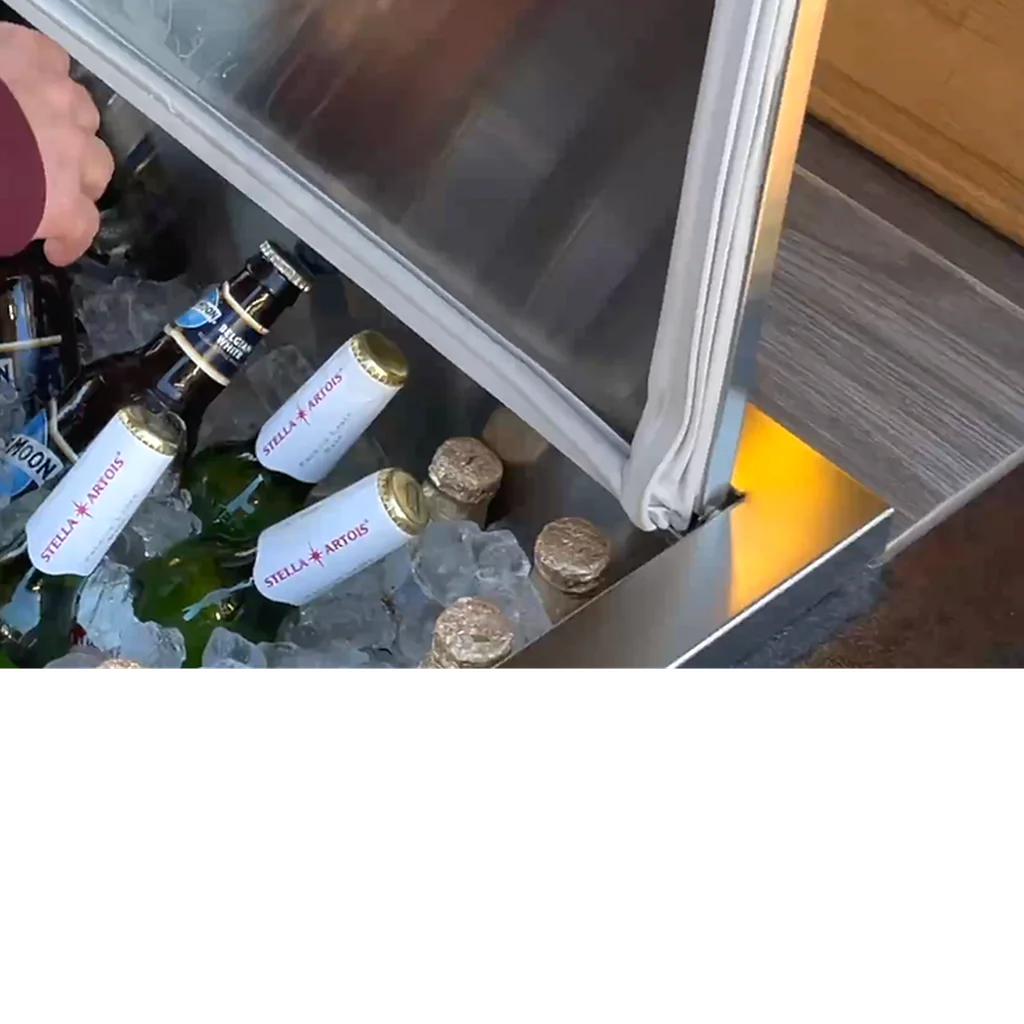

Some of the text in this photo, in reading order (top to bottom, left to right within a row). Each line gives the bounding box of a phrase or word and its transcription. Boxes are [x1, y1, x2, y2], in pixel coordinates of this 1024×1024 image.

[216, 335, 245, 360] WHITE
[218, 323, 253, 353] BELGIAN
[262, 419, 298, 457] STELLA
[306, 373, 345, 411] ARTOIS
[4, 436, 58, 480] MOON
[40, 517, 79, 564] STELLA
[87, 456, 126, 505] ARTOIS
[263, 522, 370, 589] STELLA ARTOIS
